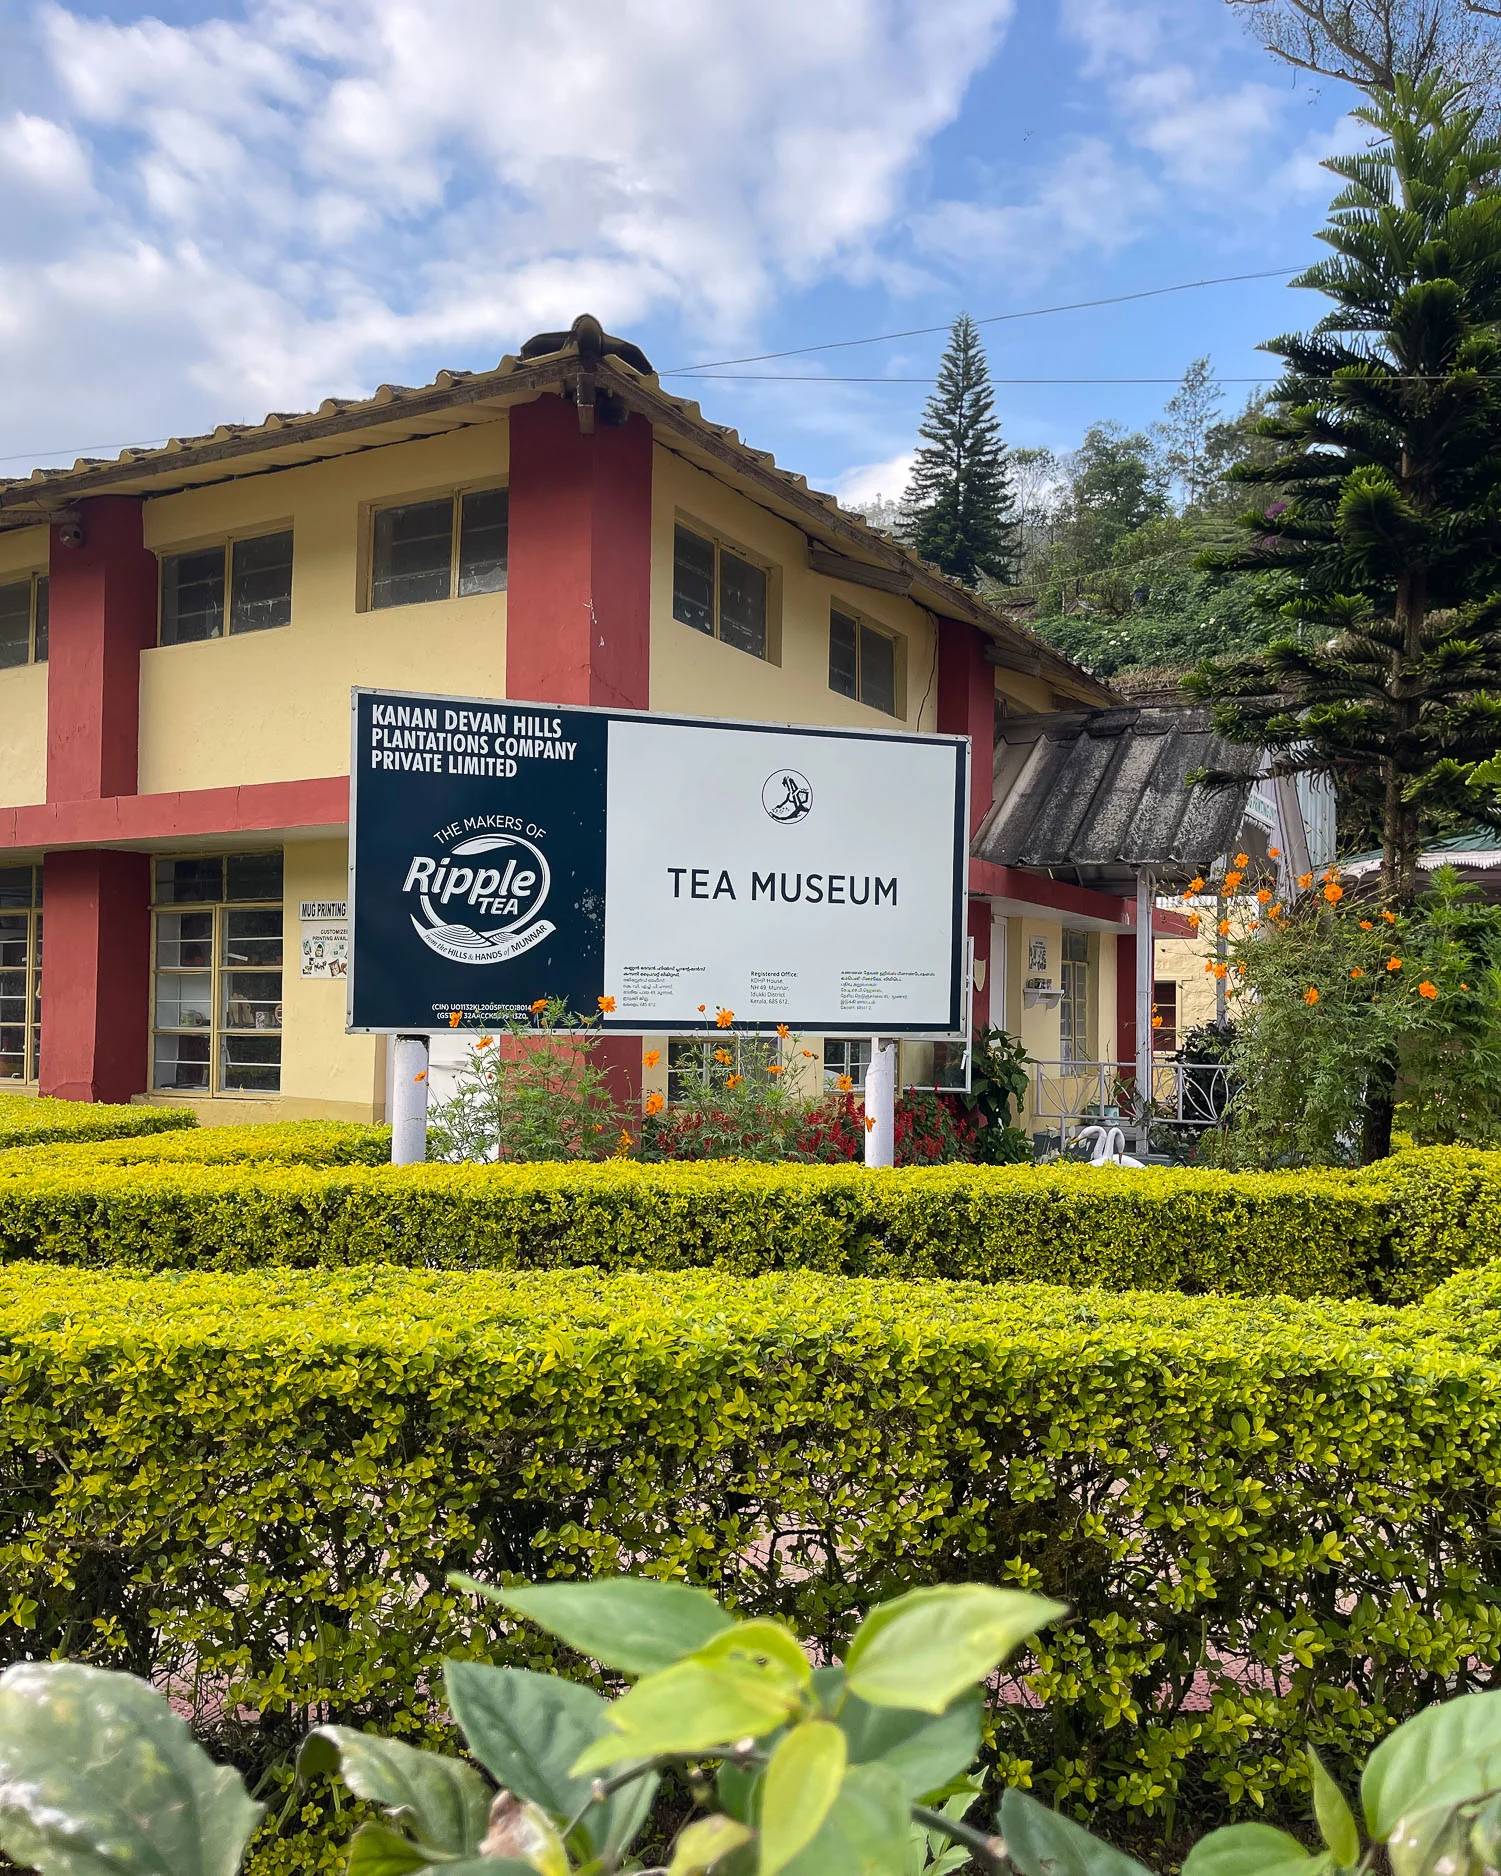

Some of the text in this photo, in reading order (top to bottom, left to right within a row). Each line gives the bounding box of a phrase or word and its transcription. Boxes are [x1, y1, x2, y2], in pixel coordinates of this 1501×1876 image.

[372, 704, 562, 738] KANAN DEVAN HILLS
[371, 728, 578, 760] PLANTATIONS COMPANY
[371, 750, 518, 778] PRIVATE LIMITED
[433, 815, 547, 844] THE MAKERS OF
[402, 856, 536, 905] Ripple
[667, 867, 898, 906] TEA MUSEUM
[302, 903, 346, 917] MUG PRINTING
[478, 897, 518, 915] TEA
[424, 934, 437, 946] from
[437, 943, 448, 953] the
[447, 949, 468, 960] HILLS
[475, 950, 503, 960] HANDS
[503, 946, 511, 957] of
[511, 925, 548, 952] MUNNAR
[432, 1003, 449, 1011] (CIN)
